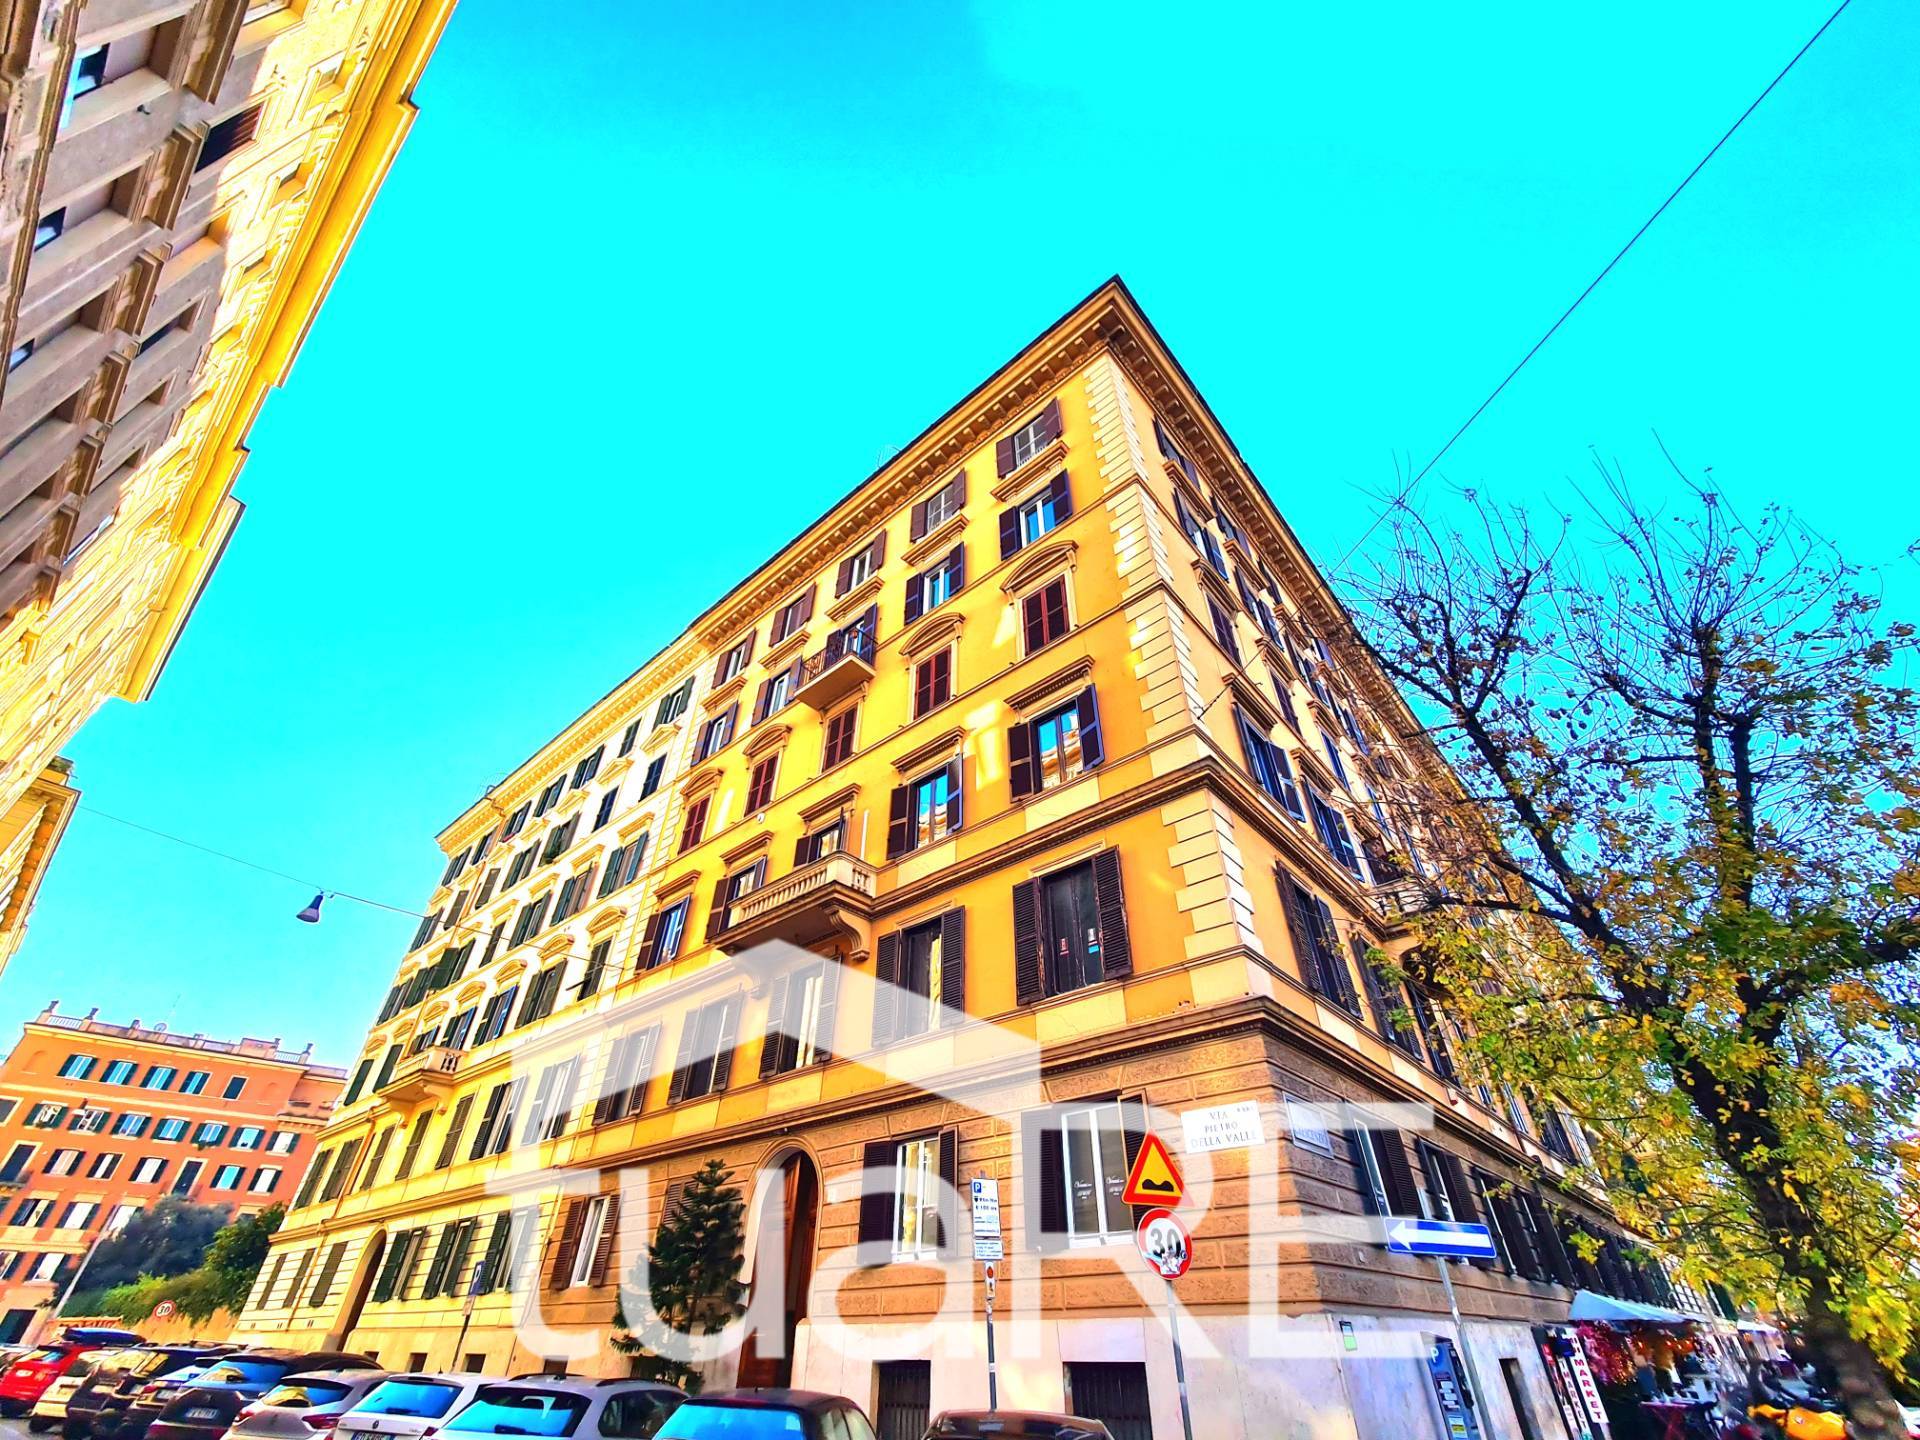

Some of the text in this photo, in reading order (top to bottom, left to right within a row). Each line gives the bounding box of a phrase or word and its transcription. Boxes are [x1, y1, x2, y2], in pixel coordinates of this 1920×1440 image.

[1209, 1111, 1229, 1120] VIA
[1204, 1121, 1238, 1133] PIETRO
[1190, 1136, 1221, 1149] DELLA
[1150, 1227, 1182, 1259] 30
[157, 1304, 171, 1315] 30
[1574, 1359, 1602, 1420] MARKET
